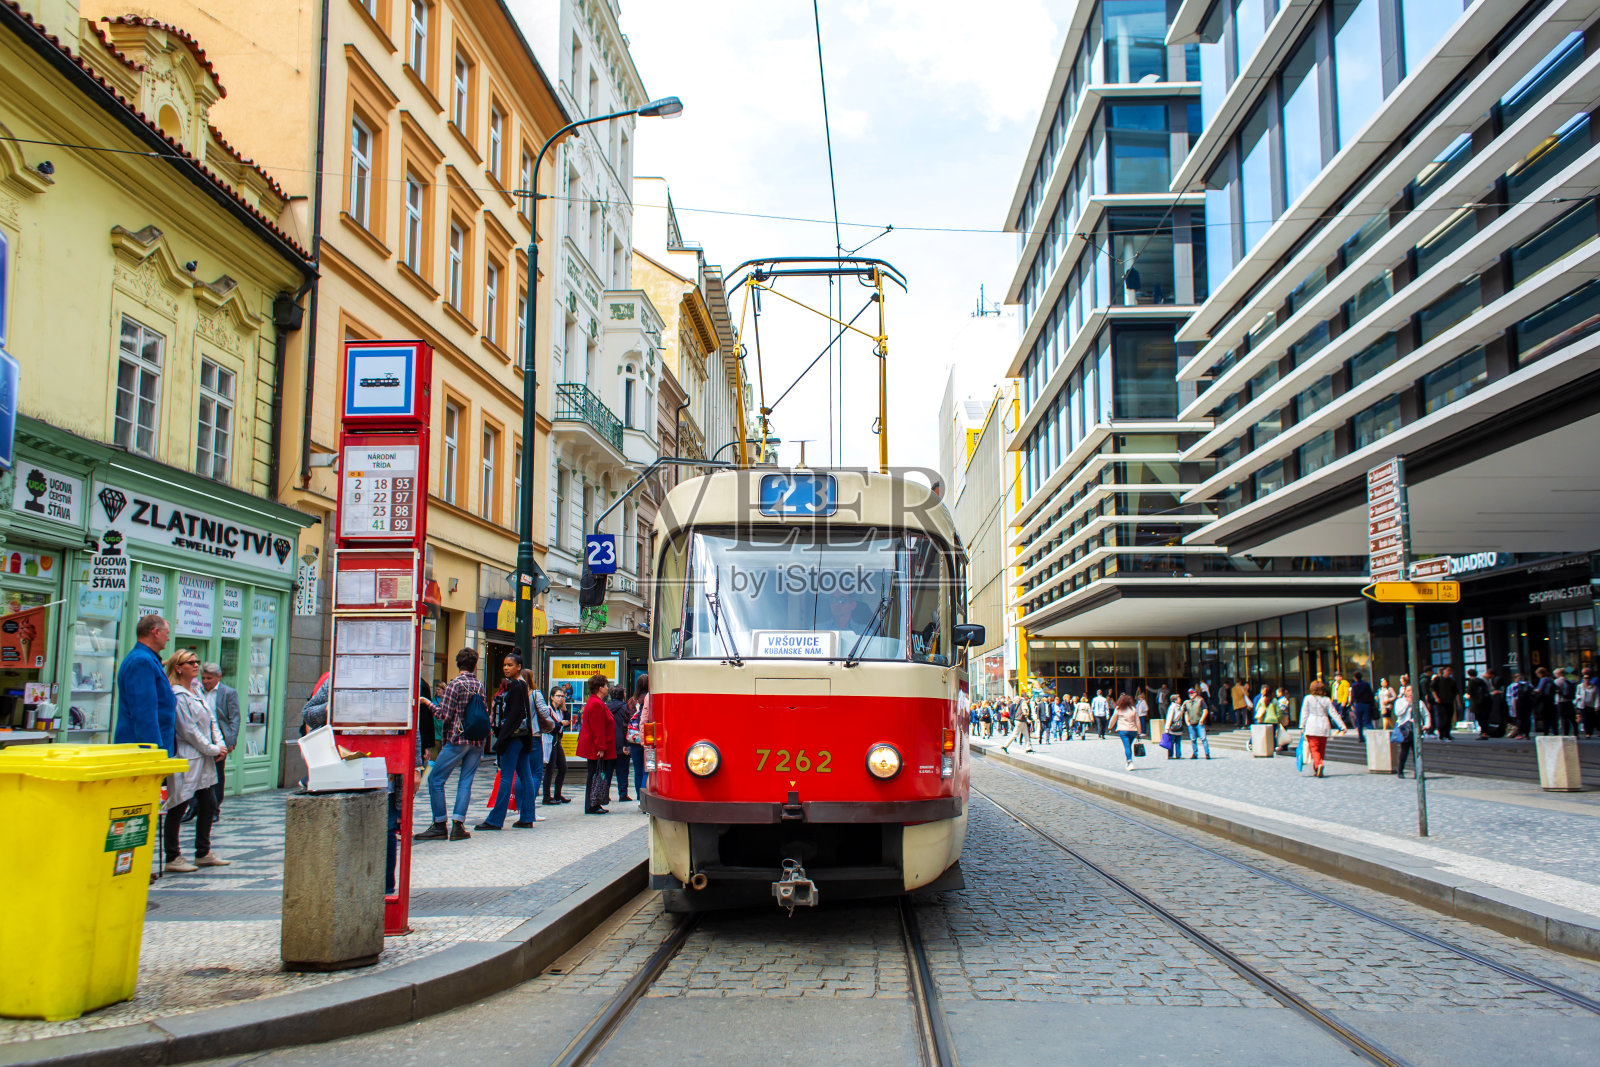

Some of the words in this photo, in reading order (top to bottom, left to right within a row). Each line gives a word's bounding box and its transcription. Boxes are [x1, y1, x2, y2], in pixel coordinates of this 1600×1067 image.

[372, 461, 391, 469] TŘÍDA
[28, 479, 46, 491] UGO
[50, 477, 72, 495] UGOVA
[354, 479, 362, 490] 2
[374, 479, 388, 490] 18
[396, 478, 410, 490] 93
[49, 490, 72, 506] ČERSTVÁ
[354, 492, 361, 503] 9
[373, 492, 387, 503] 22
[395, 492, 410, 503] 97
[769, 475, 829, 512] 23
[47, 503, 71, 521] ŠŤÁVA
[372, 506, 386, 517] 23
[395, 505, 409, 517] 98
[131, 499, 273, 557] ZLATNICTVÍ
[371, 519, 385, 530] 41
[394, 519, 409, 530] 99
[104, 535, 122, 543] UGO
[171, 536, 236, 559] JEWELLERY
[587, 541, 616, 565] 23
[94, 557, 127, 566] UGOVA
[93, 566, 127, 576] ČERSTVÁ
[92, 576, 126, 589] ŠŤÁVA
[141, 574, 160, 584] ZLATO
[225, 589, 238, 598] GOLD
[1528, 588, 1567, 604] SHOPPING
[768, 635, 819, 647] VRŠOVICE
[764, 647, 802, 655] KUBÁNSKÉ
[804, 647, 824, 655] NÁM.
[756, 748, 832, 773] 7262
